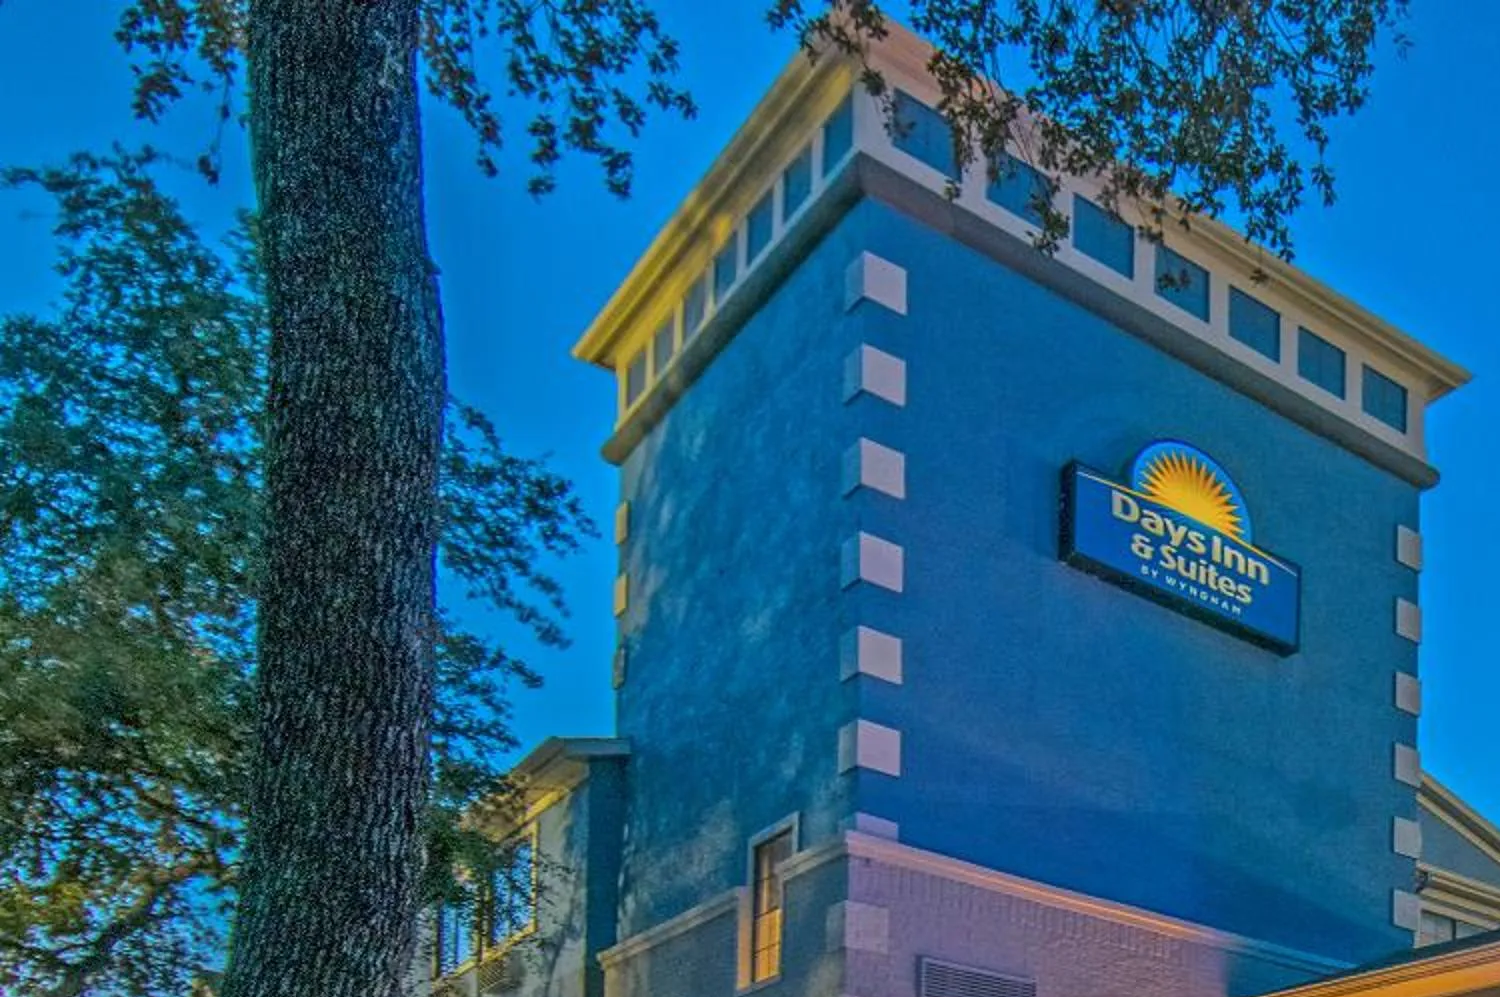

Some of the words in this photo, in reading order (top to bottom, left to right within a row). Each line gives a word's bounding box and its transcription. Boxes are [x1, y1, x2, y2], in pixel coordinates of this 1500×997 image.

[1111, 489, 1205, 555] Days
[1212, 534, 1270, 585] Inn
[1131, 533, 1154, 560] &
[1159, 544, 1252, 604] Suites
[1140, 564, 1159, 579] BY
